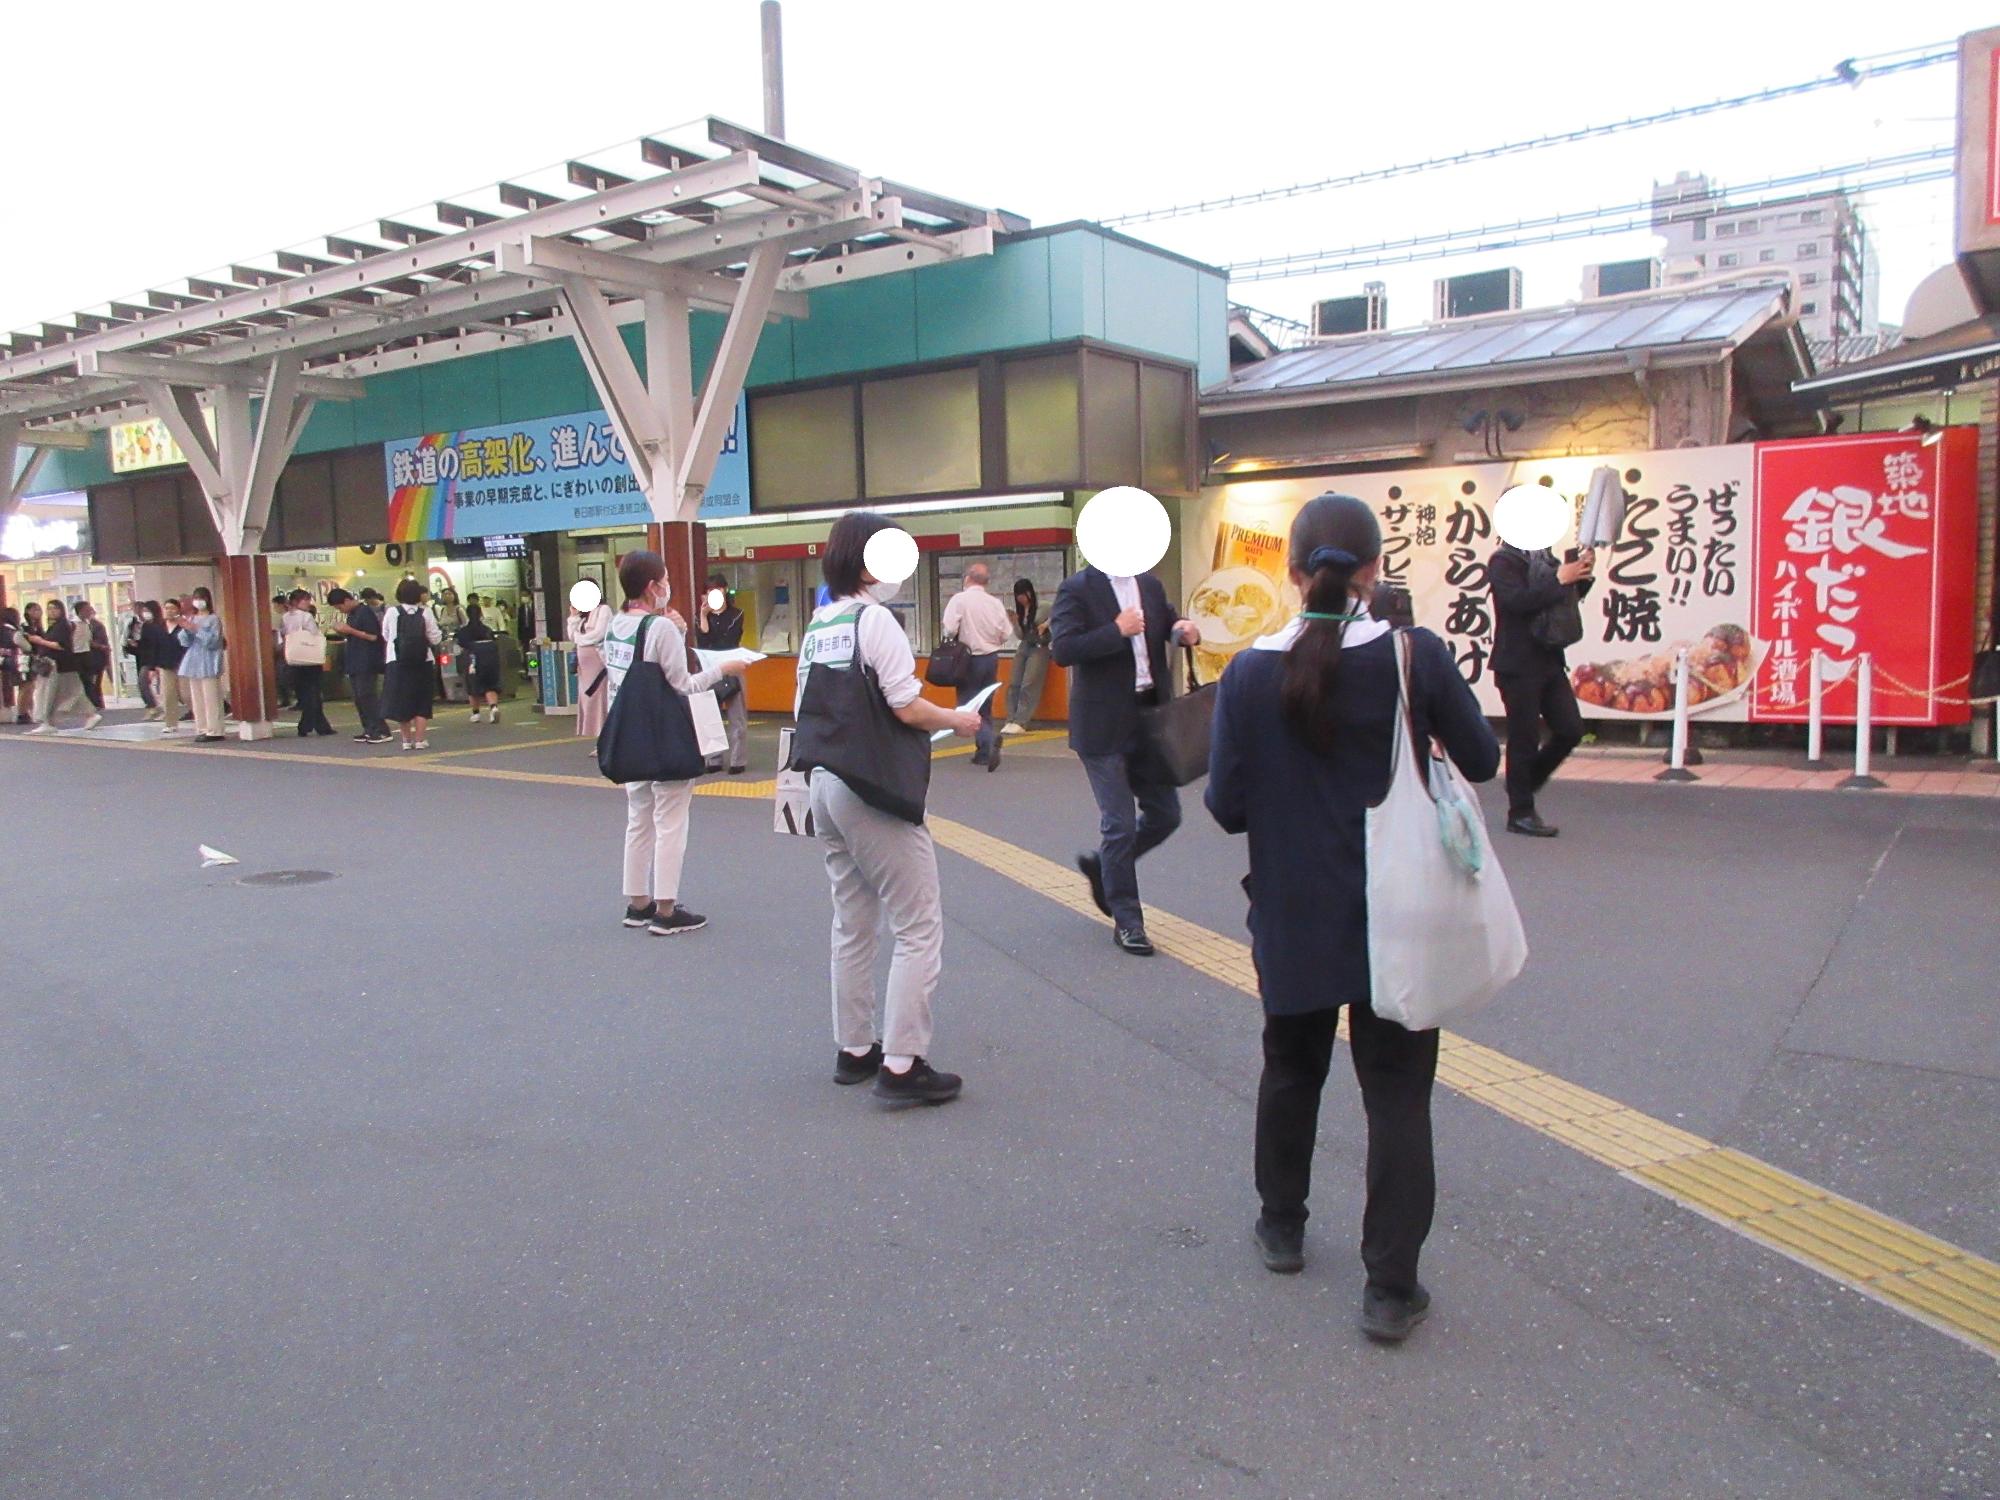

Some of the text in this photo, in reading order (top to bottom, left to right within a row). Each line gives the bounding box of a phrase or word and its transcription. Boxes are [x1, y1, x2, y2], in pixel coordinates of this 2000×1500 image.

[1230, 523, 1283, 552] PREMIUM
[1702, 480, 1740, 597] ぜったい
[1876, 451, 1930, 520] 築地
[1445, 500, 1493, 685] からあげ
[1769, 560, 1803, 705] ハイボール酒場
[1781, 485, 1929, 682] 銀だこ
